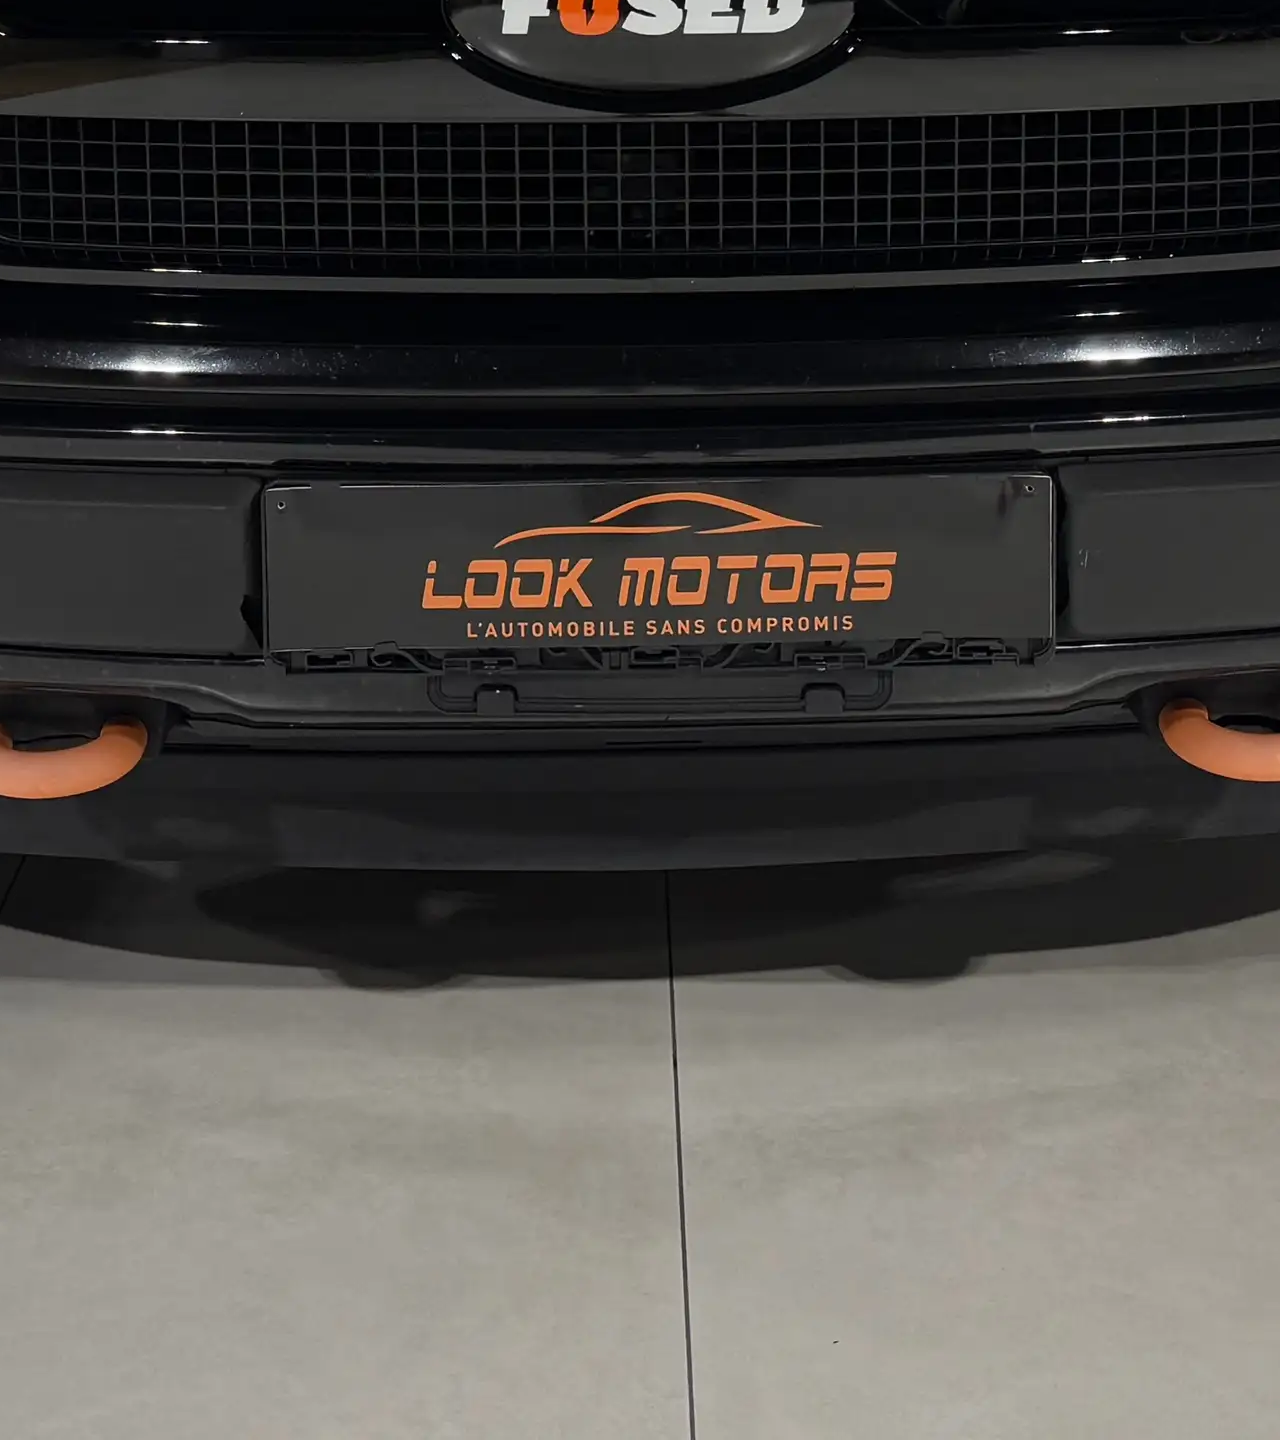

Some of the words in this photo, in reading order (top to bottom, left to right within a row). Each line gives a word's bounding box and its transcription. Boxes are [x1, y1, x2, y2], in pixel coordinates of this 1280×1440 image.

[422, 558, 593, 610] LOOK
[619, 551, 898, 606] MOTORS
[467, 620, 634, 638] L'AUTOMOBILE
[646, 619, 705, 635] SANS
[717, 615, 854, 635] COMPROMIS
